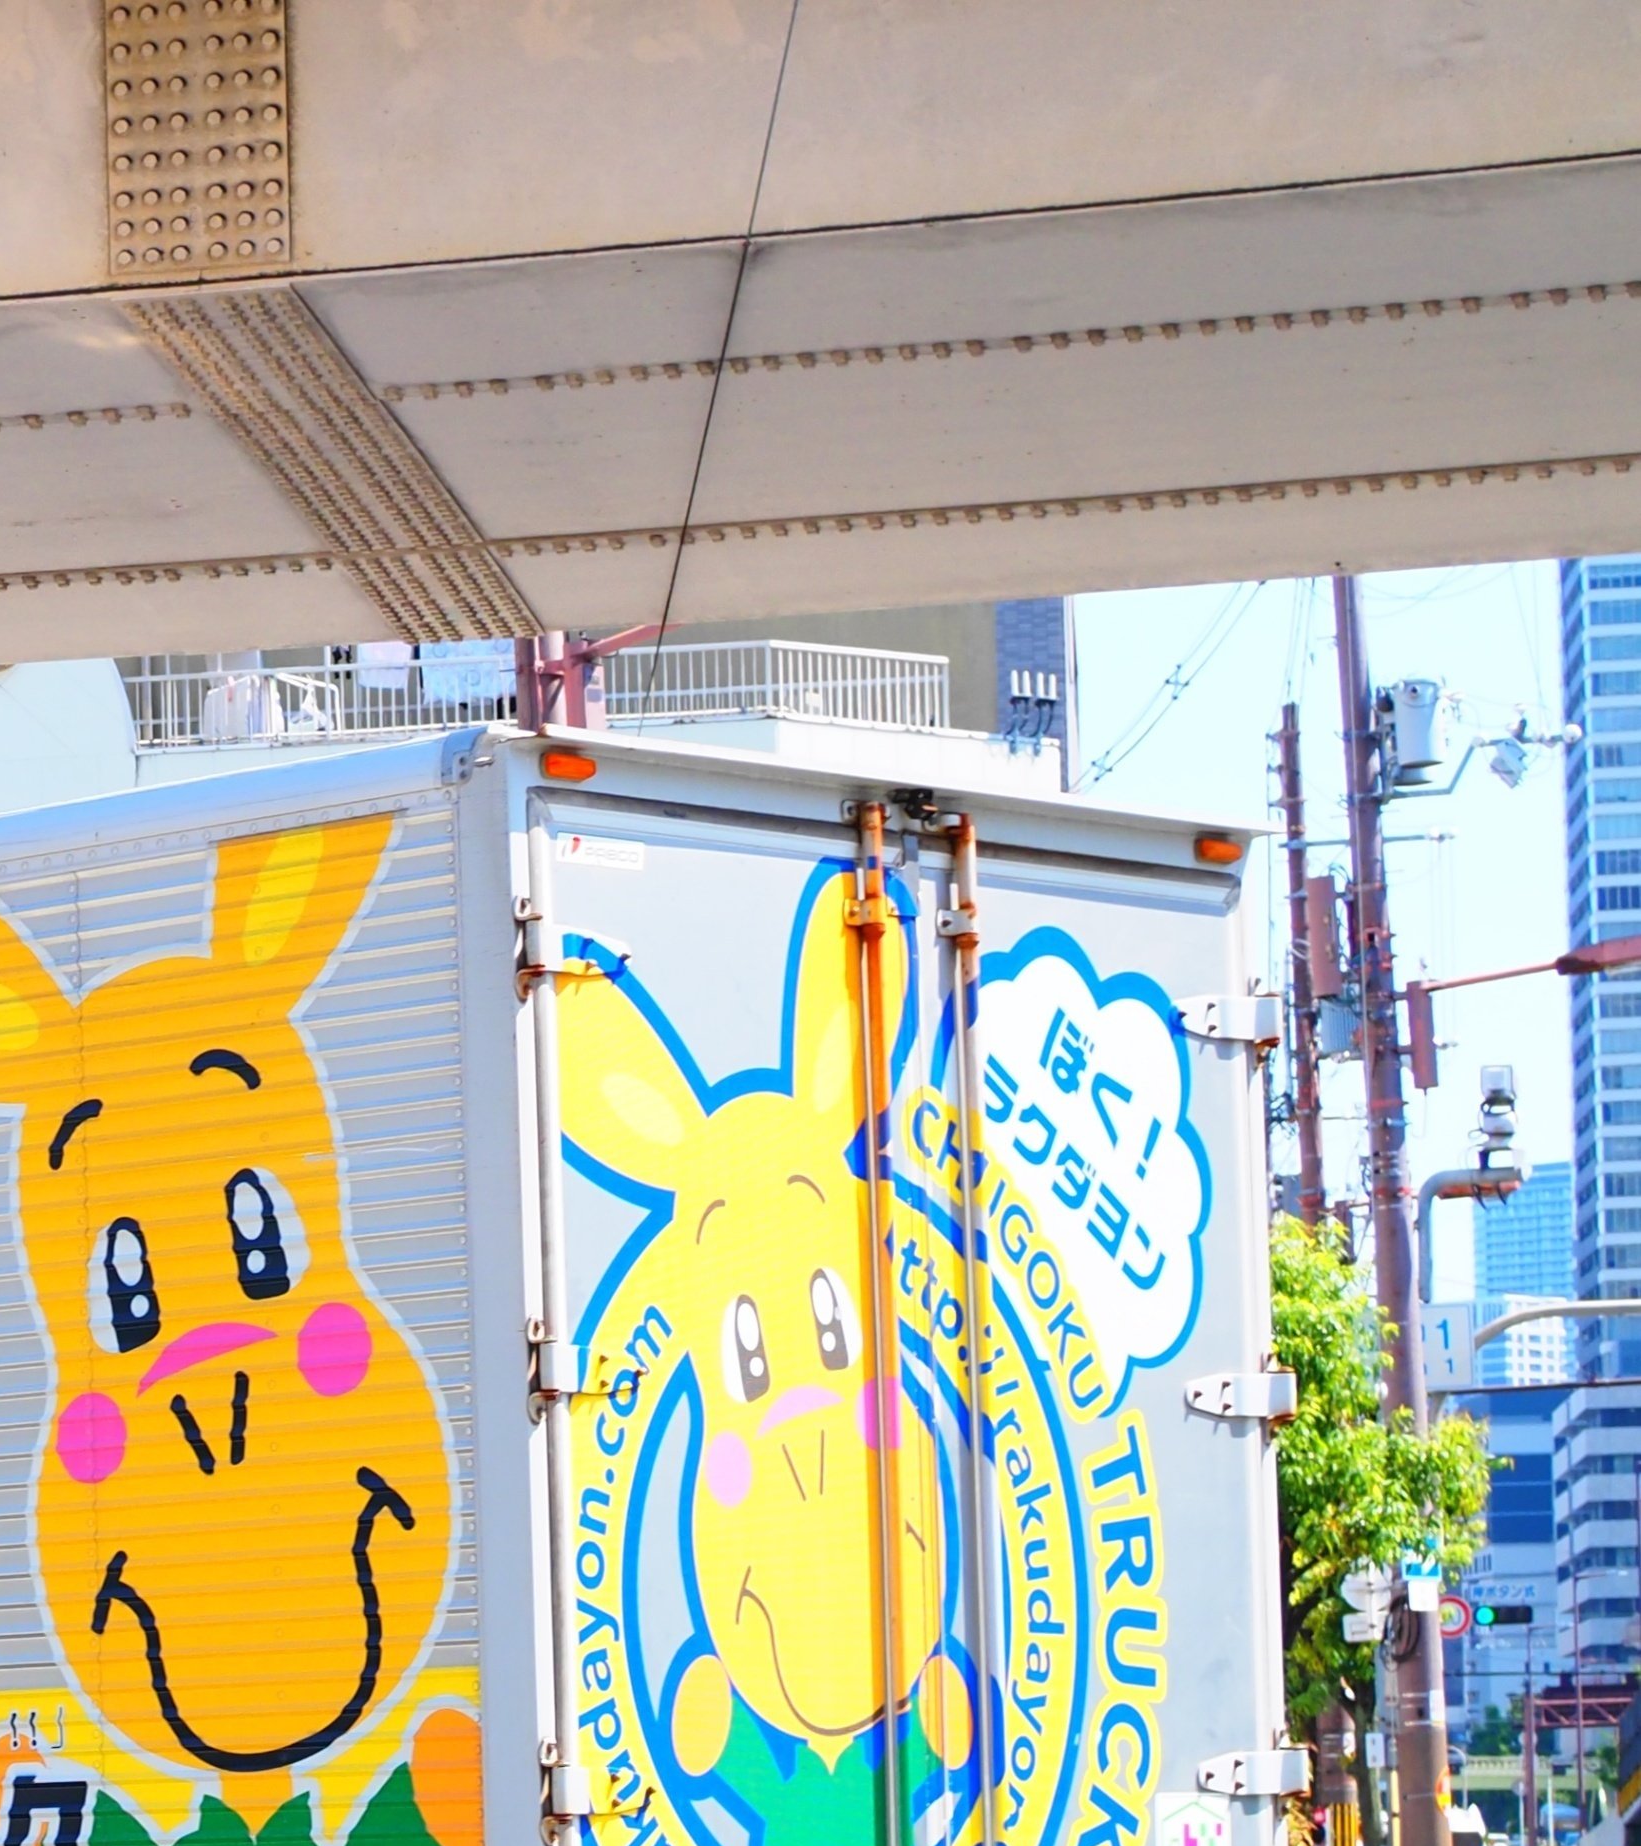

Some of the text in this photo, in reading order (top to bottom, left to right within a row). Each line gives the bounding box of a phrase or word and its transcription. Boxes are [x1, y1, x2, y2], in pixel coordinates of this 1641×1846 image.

[983, 1053, 1166, 1291] ラクダヨン
[1038, 1006, 1163, 1182] ぼく!
